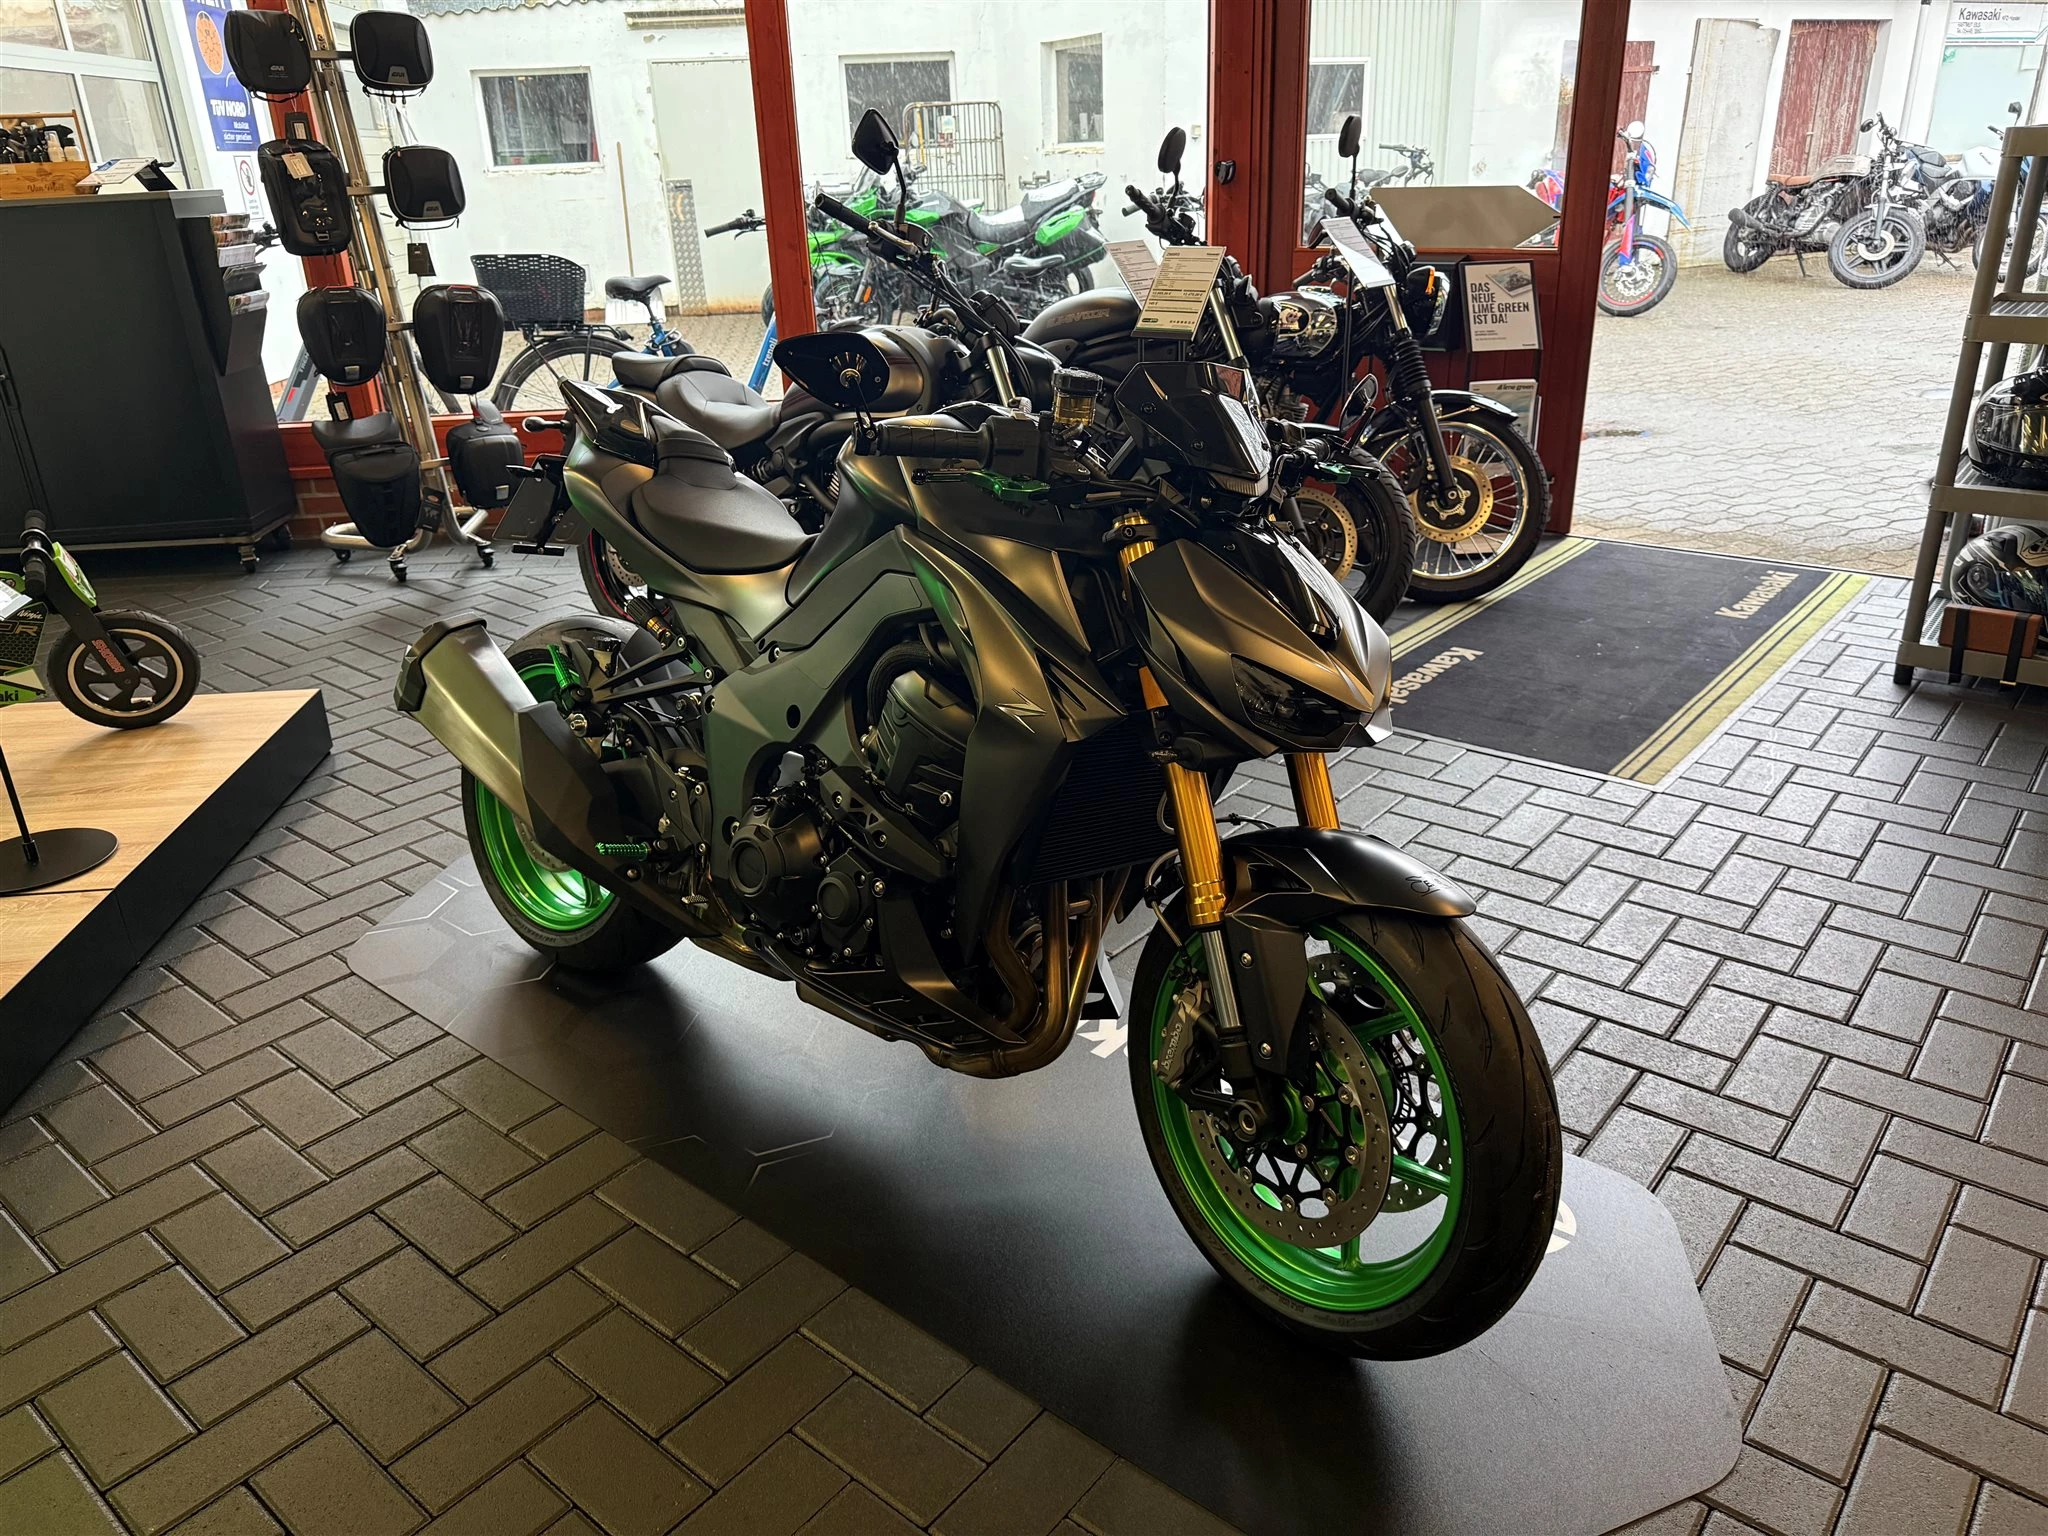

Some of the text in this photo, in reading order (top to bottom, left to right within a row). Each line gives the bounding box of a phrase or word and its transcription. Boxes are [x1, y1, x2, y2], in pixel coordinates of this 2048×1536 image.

[1959, 7, 2002, 21] Kawasaki
[225, 101, 247, 117] NORD
[1470, 282, 1490, 293] DAS
[1471, 293, 1496, 303] NEUE
[1472, 302, 1529, 314] LIME GREEN
[1473, 313, 1508, 325] IST DA!
[1714, 570, 1799, 619] Kawasaki
[17, 609, 43, 620] Ninja
[1161, 1023, 1183, 1070] brembo
